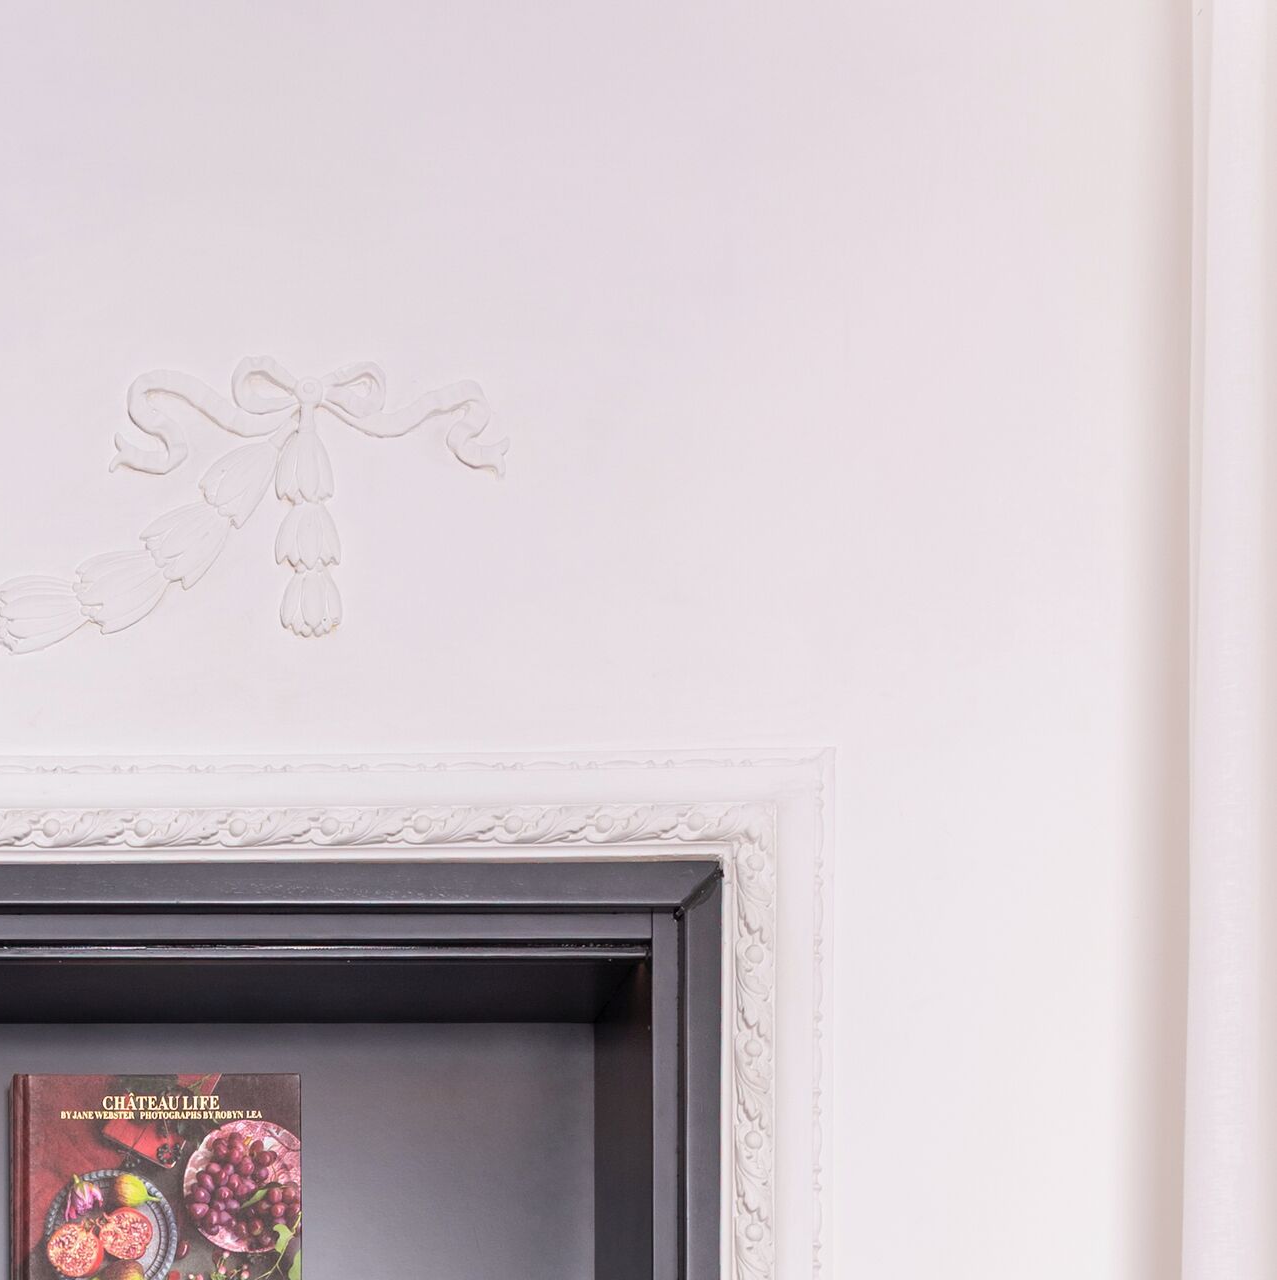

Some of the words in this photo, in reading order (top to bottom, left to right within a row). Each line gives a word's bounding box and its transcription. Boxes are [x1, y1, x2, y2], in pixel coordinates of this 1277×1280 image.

[102, 1092, 180, 1111] CHÂTEAU
[182, 1095, 220, 1110] LIFE
[60, 1111, 73, 1119] BY
[73, 1111, 94, 1119] JANE
[94, 1111, 135, 1119] WEBSTER
[140, 1111, 202, 1119] PHOTOGRAPHS
[203, 1111, 214, 1119] BY
[215, 1111, 243, 1119] ROBYN
[246, 1110, 262, 1119] LEA
